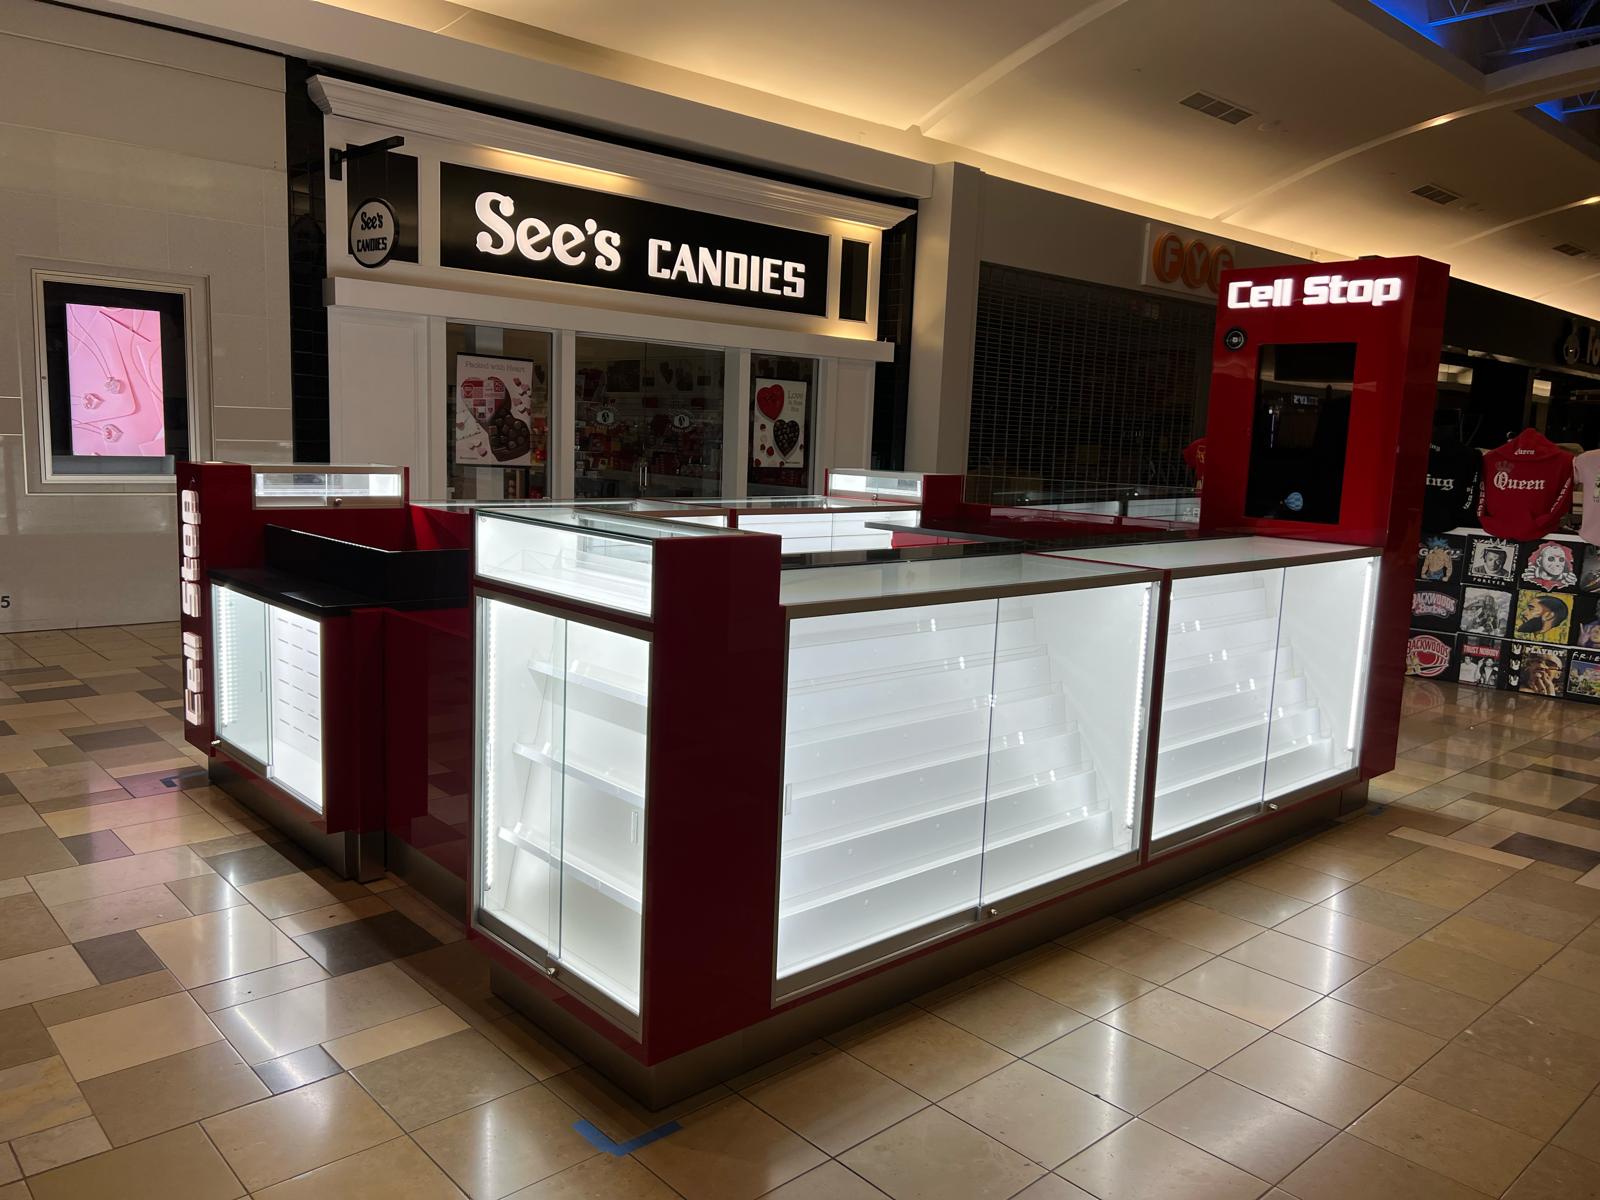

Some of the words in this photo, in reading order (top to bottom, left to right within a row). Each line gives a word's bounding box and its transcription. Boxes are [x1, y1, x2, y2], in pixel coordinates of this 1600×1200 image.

[361, 212, 383, 230] See's
[357, 237, 387, 252] CANDIES
[475, 191, 621, 272] See's
[647, 238, 806, 298] CANDIES
[1227, 278, 1294, 309] Cell
[1302, 275, 1402, 307] Stop
[1426, 474, 1454, 490] ing
[1493, 471, 1545, 491] Queen
[181, 489, 201, 618] Stop
[1, 596, 10, 608] 5
[183, 631, 203, 726] Cell
